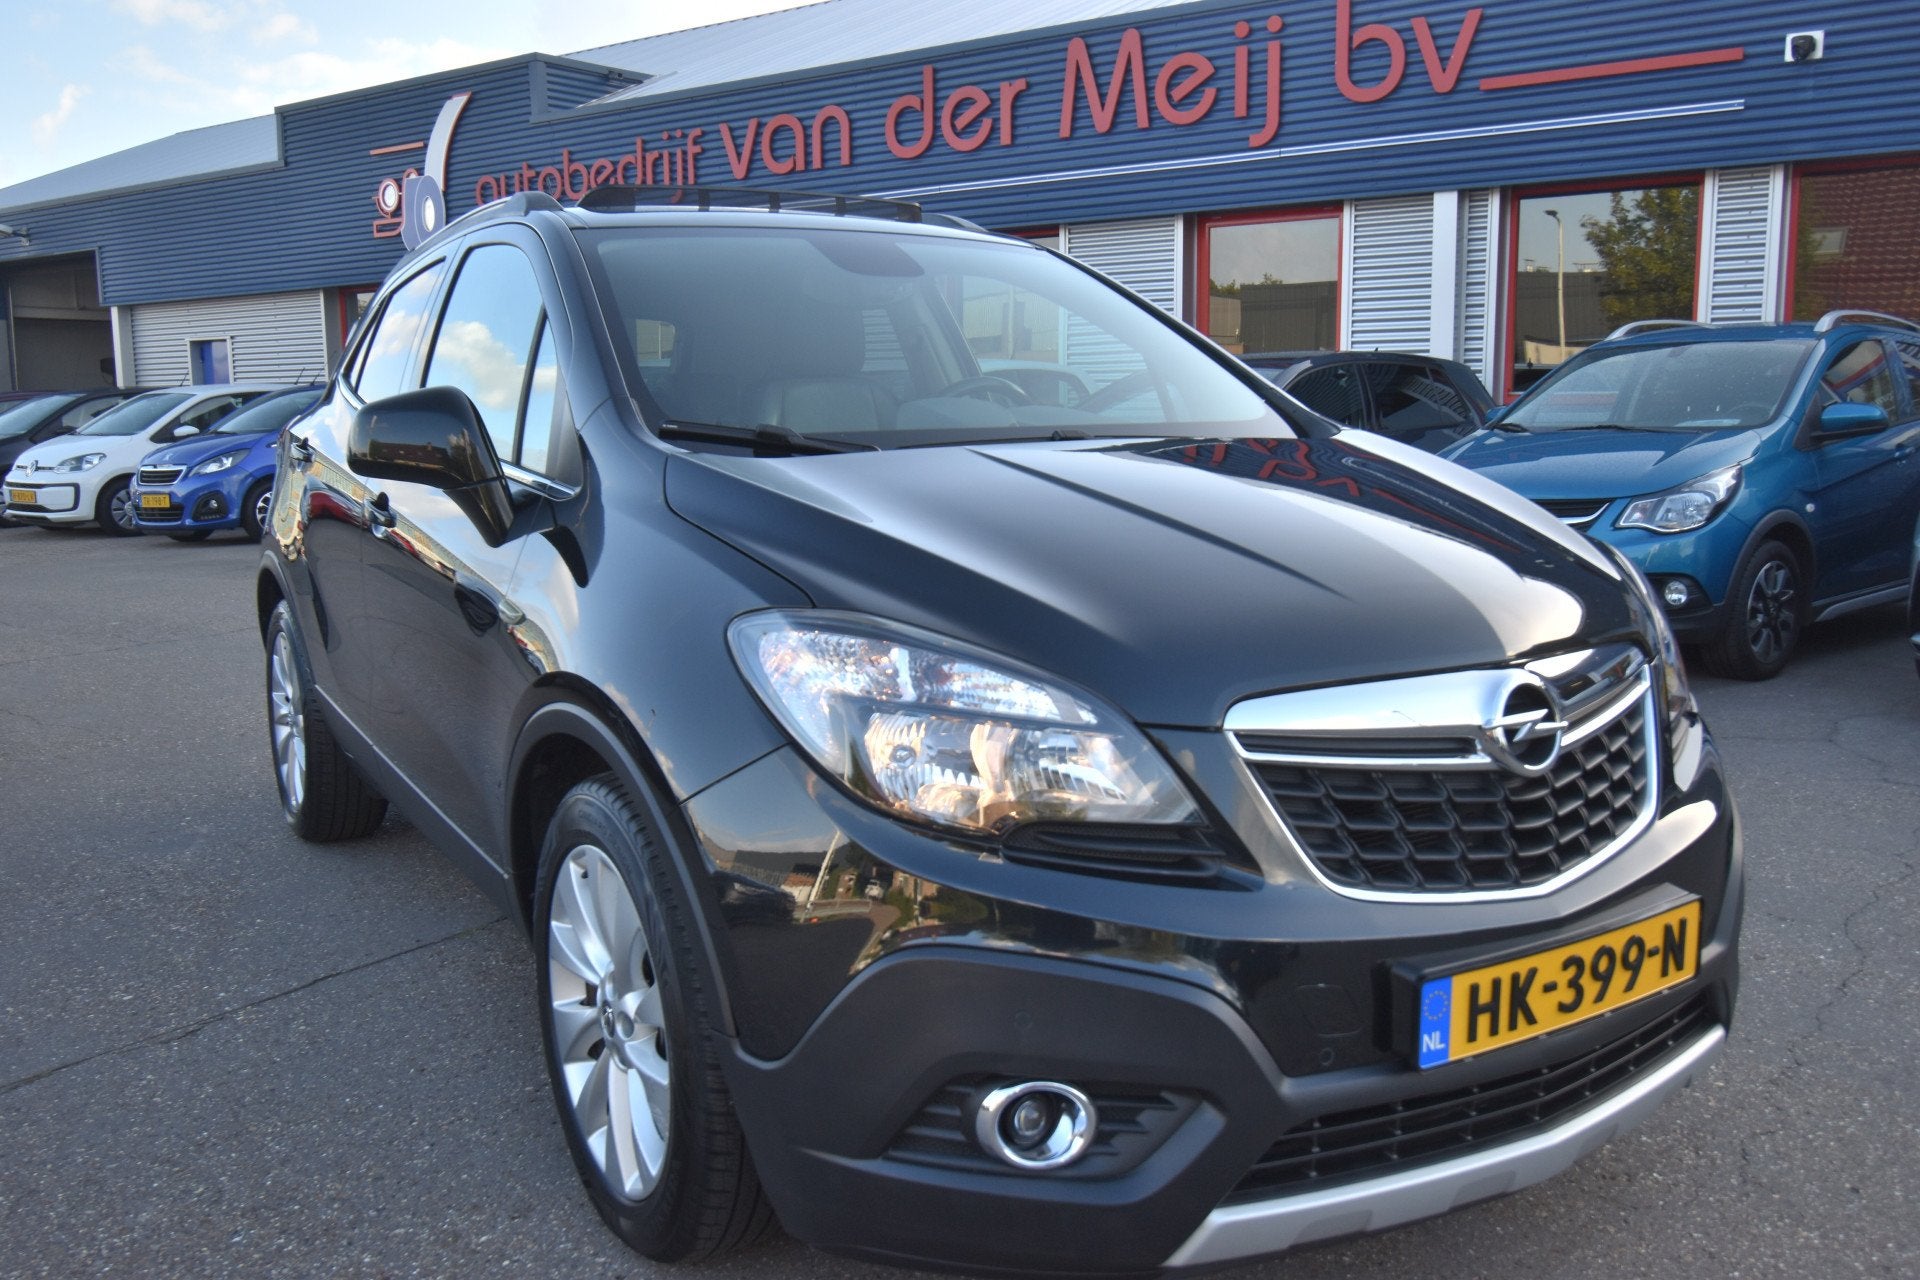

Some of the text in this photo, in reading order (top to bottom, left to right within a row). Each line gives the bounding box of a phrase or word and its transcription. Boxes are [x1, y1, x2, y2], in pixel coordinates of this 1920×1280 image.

[475, 0, 1484, 205] autobedrijf van der Meij bv
[1422, 1031, 1445, 1052] NL
[1467, 917, 1687, 1043] HK-399-N
